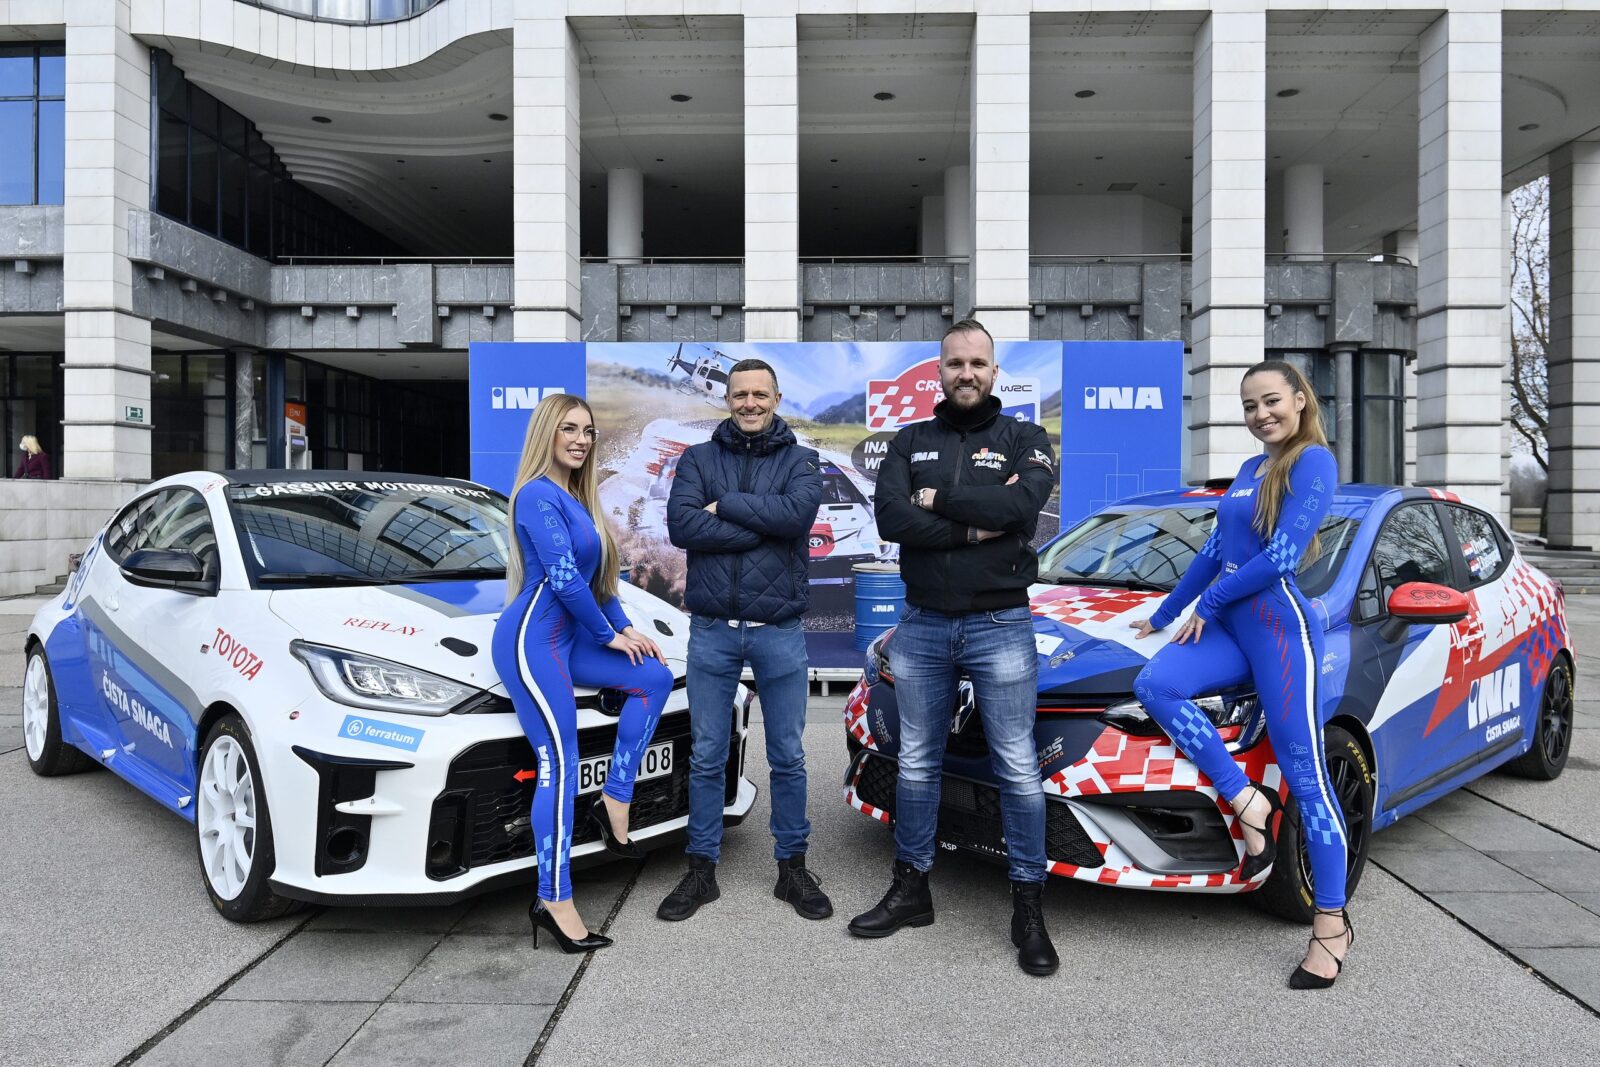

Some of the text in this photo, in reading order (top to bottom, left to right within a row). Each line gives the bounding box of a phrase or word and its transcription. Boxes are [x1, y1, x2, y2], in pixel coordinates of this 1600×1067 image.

[256, 481, 491, 500] GASSNER MOTORSPORT
[343, 617, 424, 636] REPLAY
[212, 627, 264, 680] TOYOTA
[102, 668, 173, 748] ČISTA SNAGA
[365, 726, 416, 745] ferratum
[1485, 715, 1520, 743] ČISTA SNAGA
